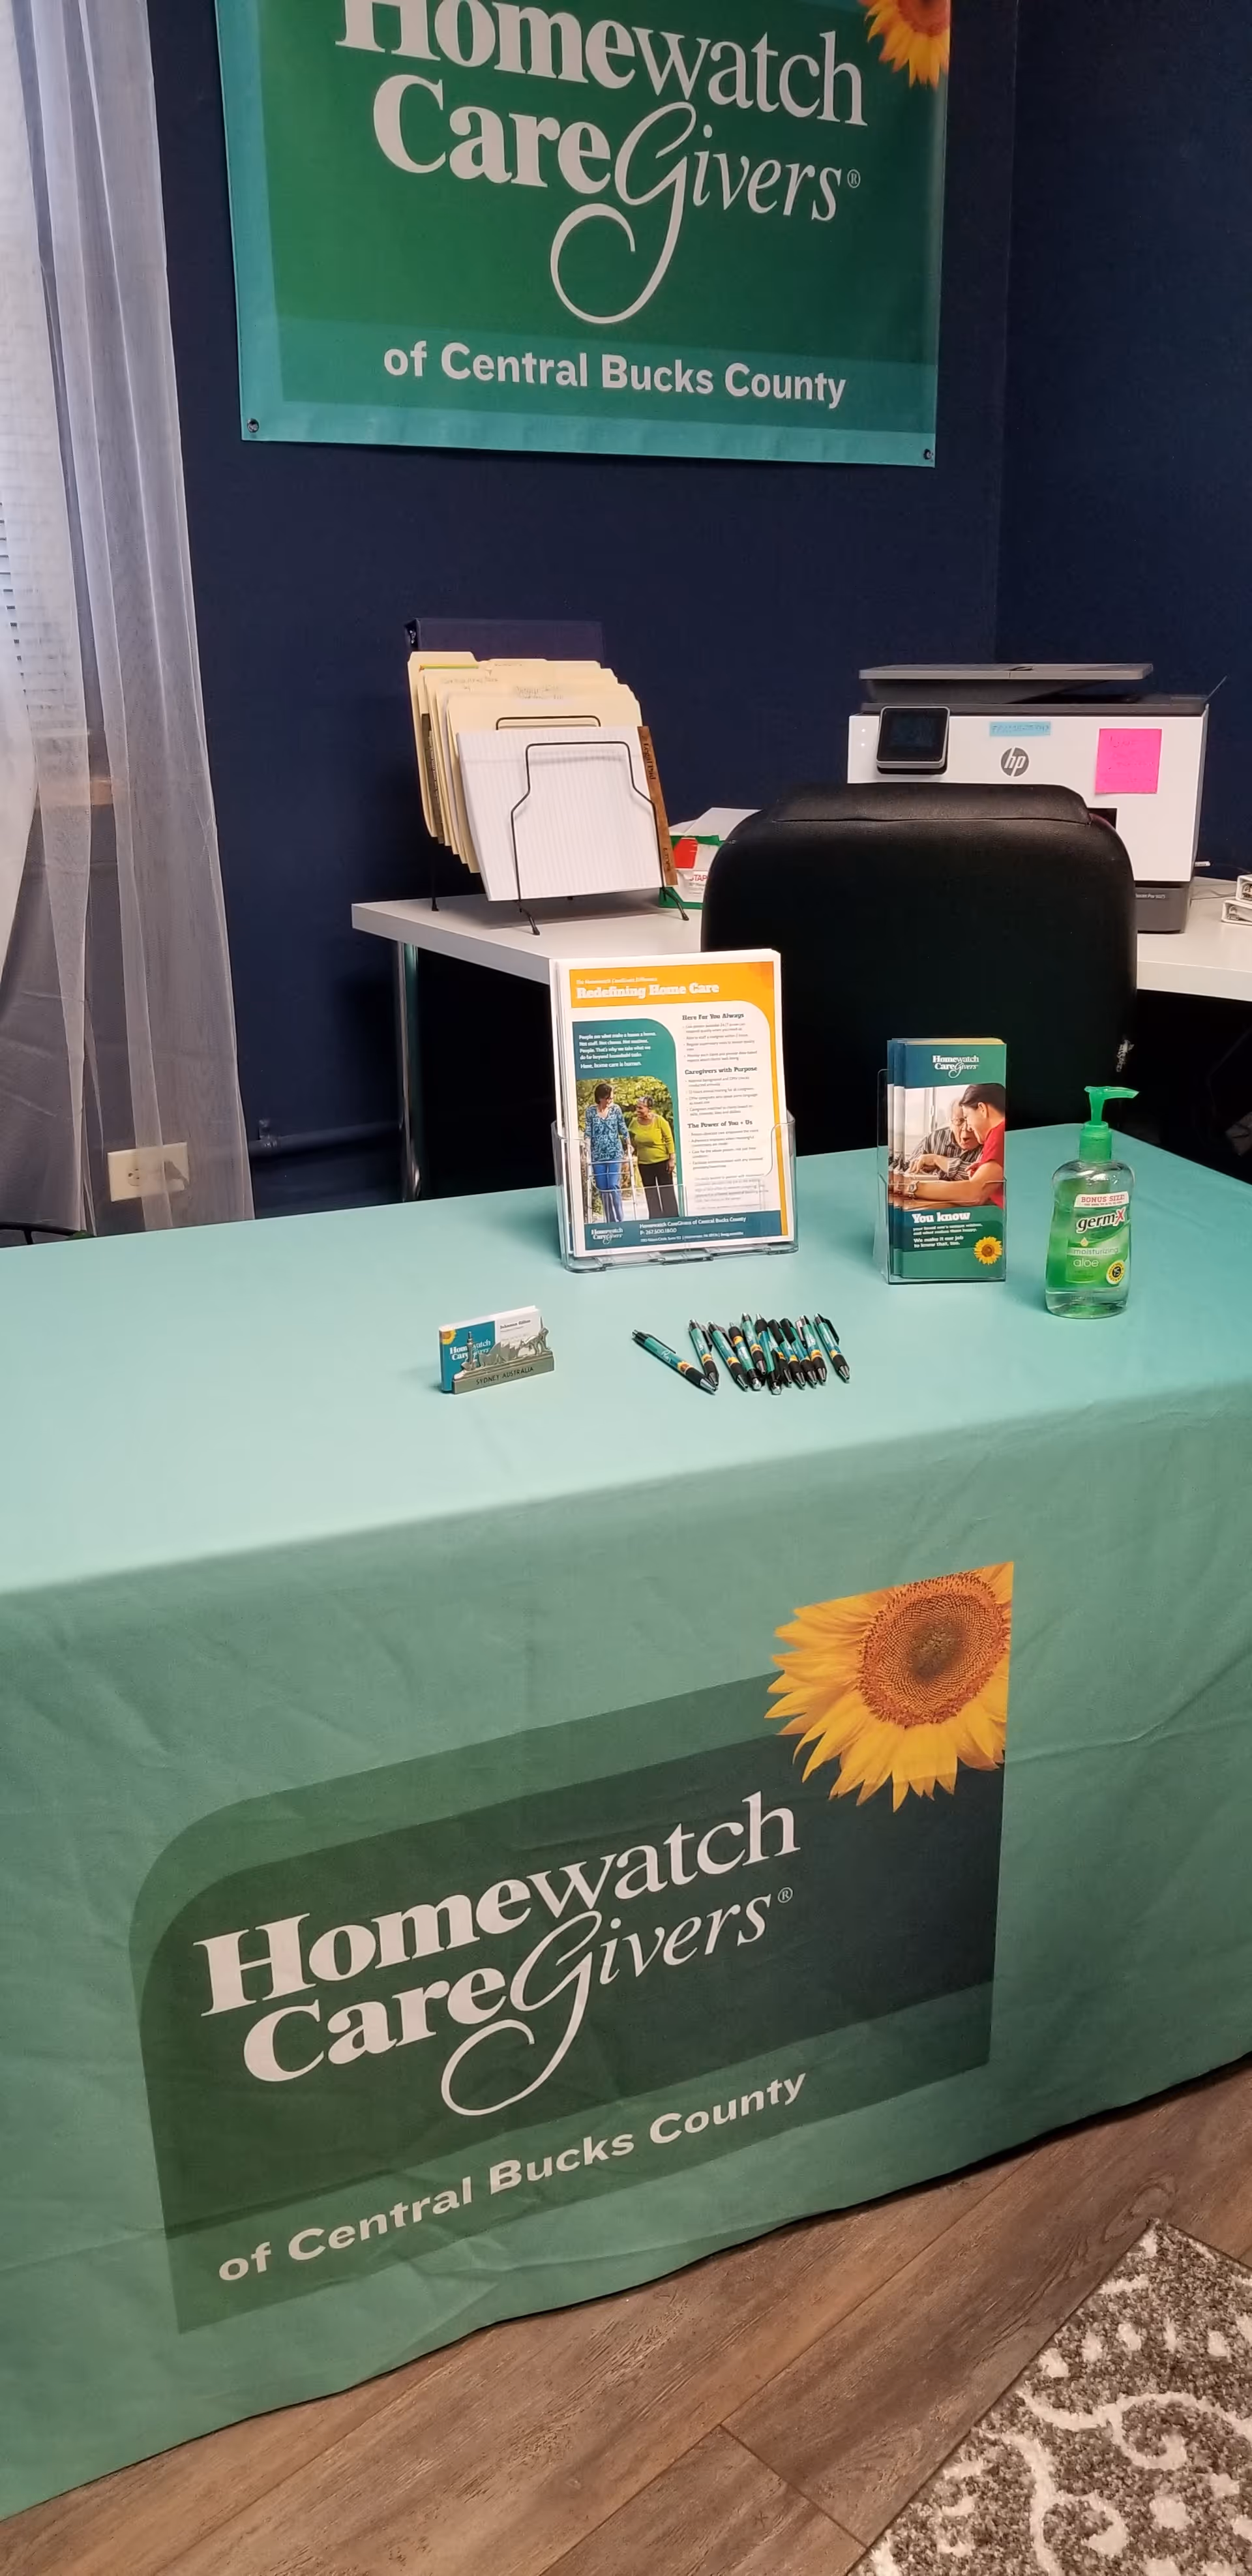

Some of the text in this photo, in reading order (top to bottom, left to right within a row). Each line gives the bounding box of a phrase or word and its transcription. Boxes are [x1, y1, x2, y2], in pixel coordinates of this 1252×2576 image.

[335, 0, 868, 126] Homewatch
[384, 340, 846, 409] of Central Bucks County
[1004, 747, 1027, 776] hp
[576, 981, 719, 999] Redefining Home Care
[912, 1212, 971, 1223] You know
[1073, 1257, 1099, 1267] aloe
[476, 1367, 534, 1385] SYDNEY AUSTRALIA
[194, 1790, 799, 2016] Homewatch
[219, 2073, 806, 2281] of Central Bucks County
